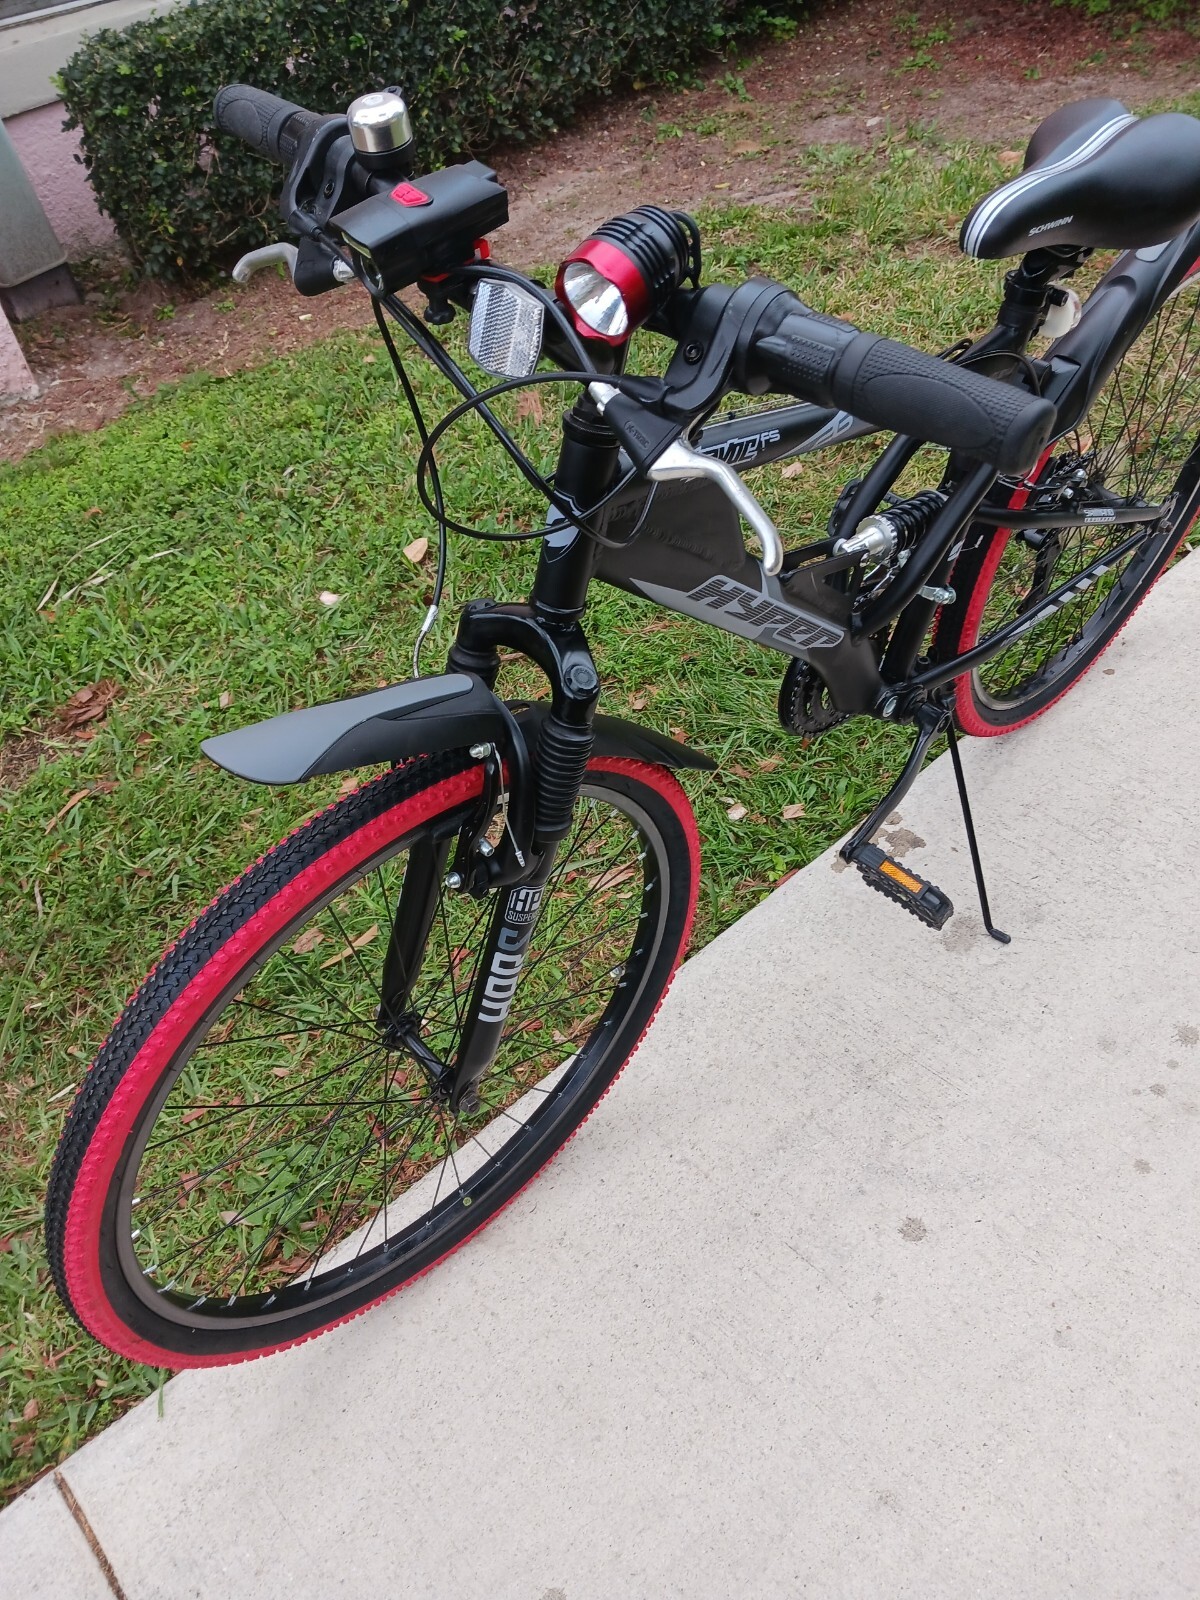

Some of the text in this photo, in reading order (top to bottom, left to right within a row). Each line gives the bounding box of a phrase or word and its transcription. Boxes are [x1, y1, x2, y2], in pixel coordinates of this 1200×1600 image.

[1028, 214, 1074, 237] SCHWINN
[760, 428, 781, 448] FS
[507, 910, 535, 922] SUSPE
